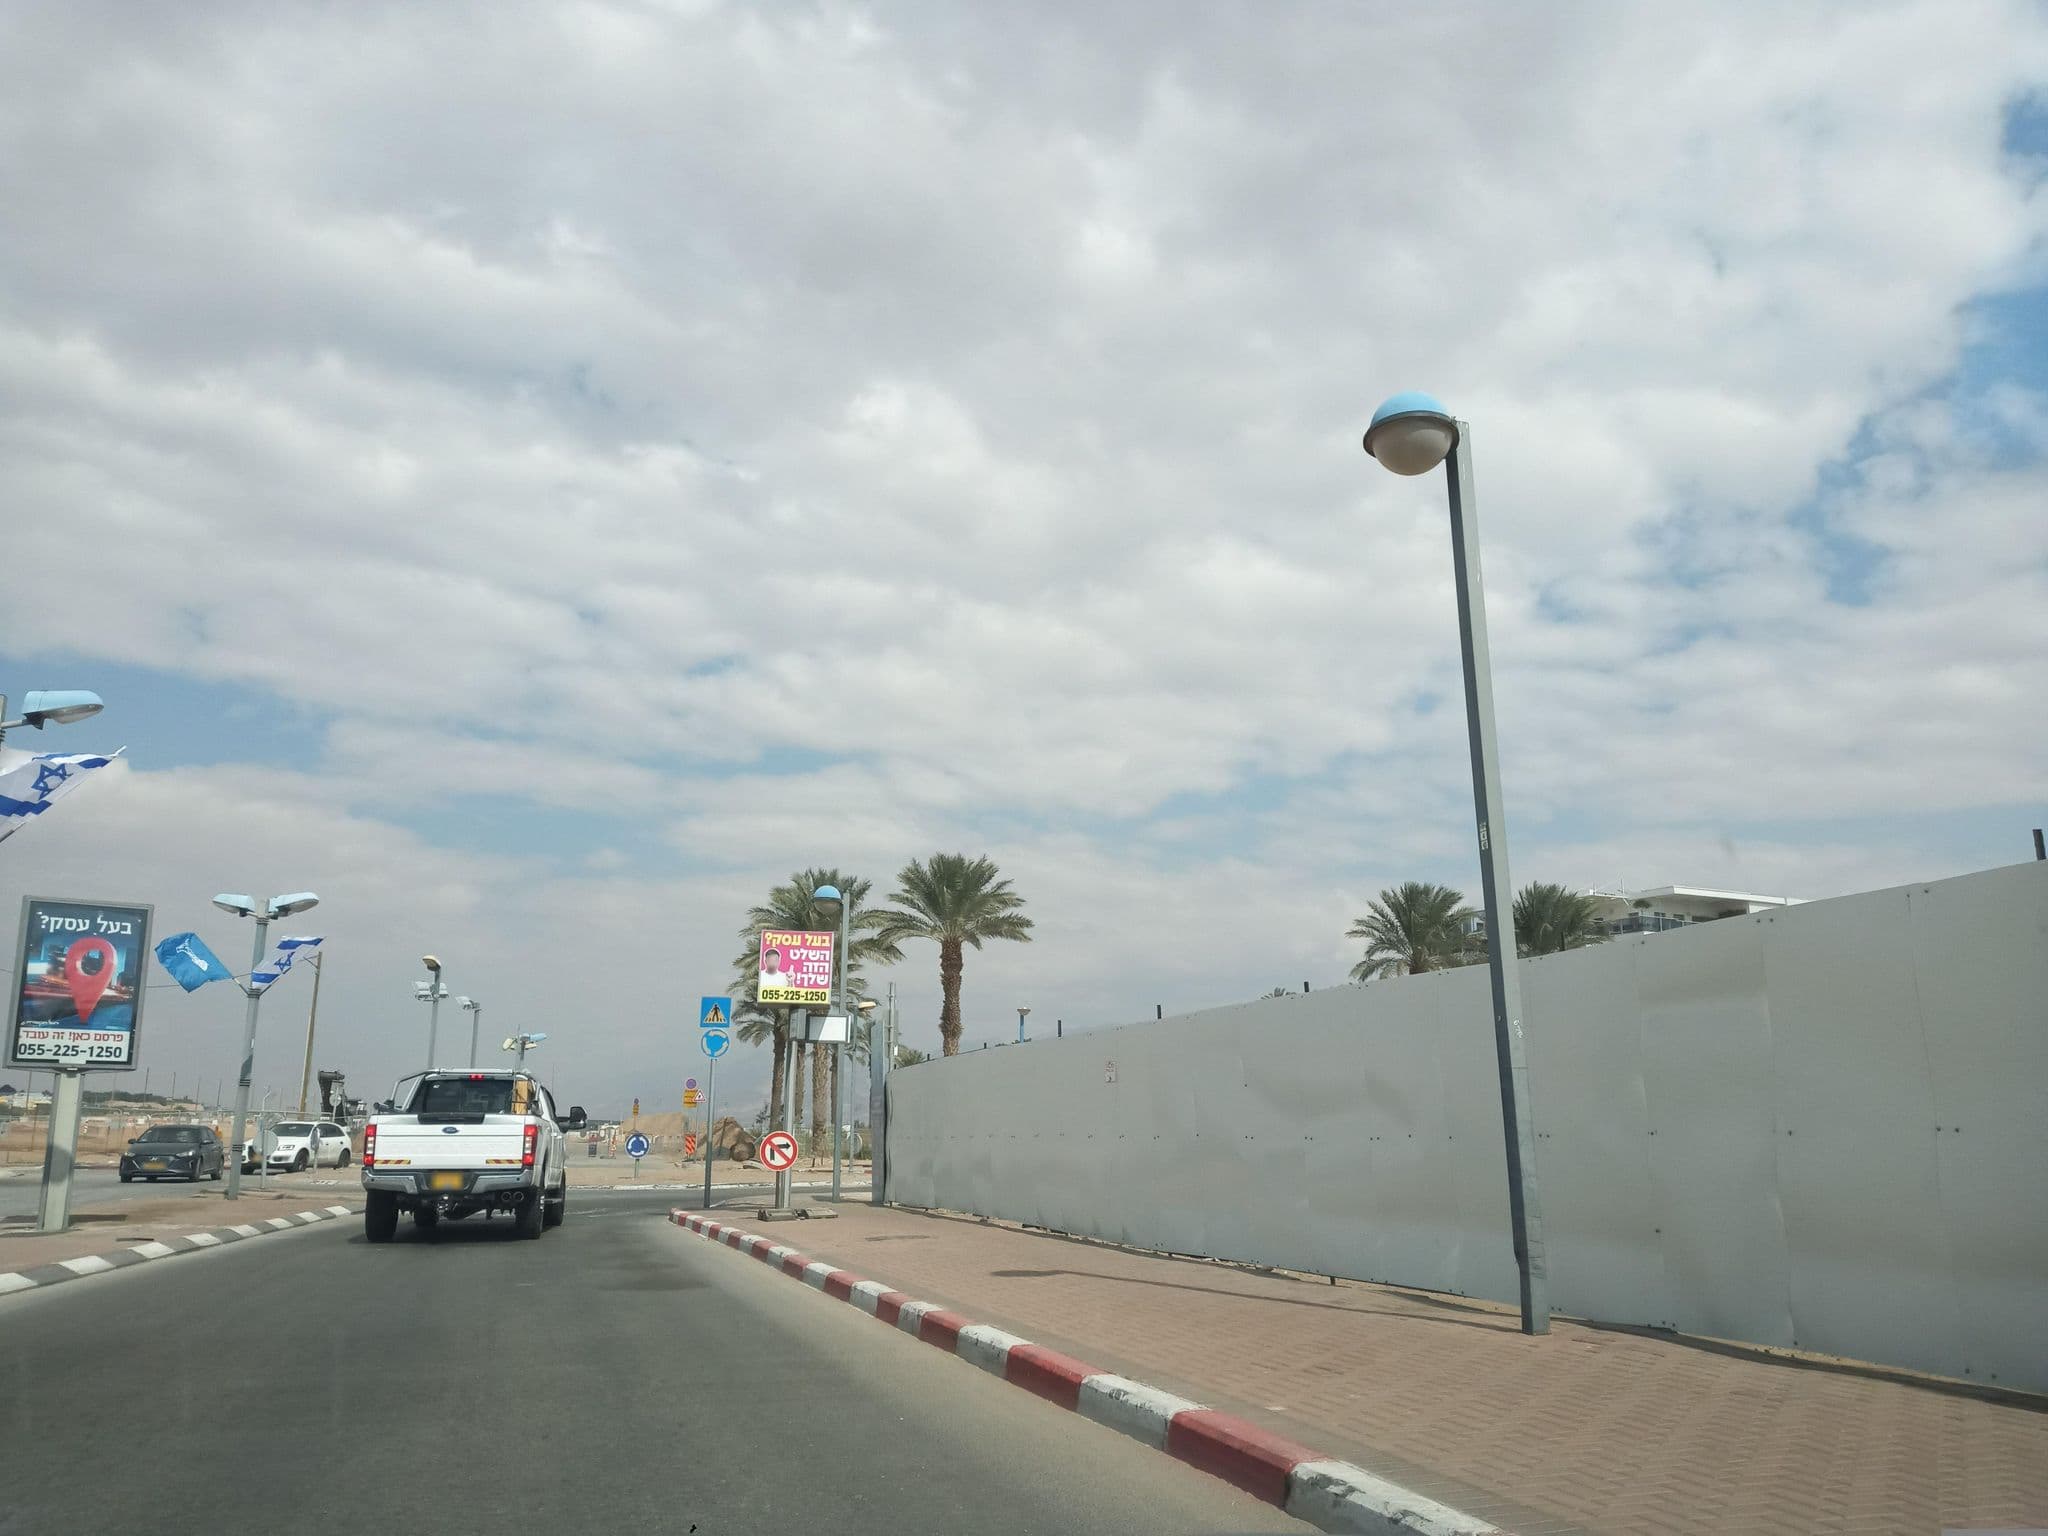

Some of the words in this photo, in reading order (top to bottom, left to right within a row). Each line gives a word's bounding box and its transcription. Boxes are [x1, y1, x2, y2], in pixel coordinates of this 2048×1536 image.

[40, 914, 90, 933] עסק?
[97, 914, 132, 935] בעל
[765, 933, 801, 947] עסק?
[805, 934, 830, 946] בעל
[790, 948, 829, 960] השלט
[803, 961, 829, 972] הזה
[797, 972, 828, 986] שלך!
[762, 990, 826, 1001] 055-225-1250
[22, 1030, 49, 1040] עובד
[52, 1031, 65, 1040] זה
[69, 1031, 91, 1042] כאן!
[94, 1033, 124, 1042] פרסם
[18, 1043, 122, 1058] 055-225-1250
